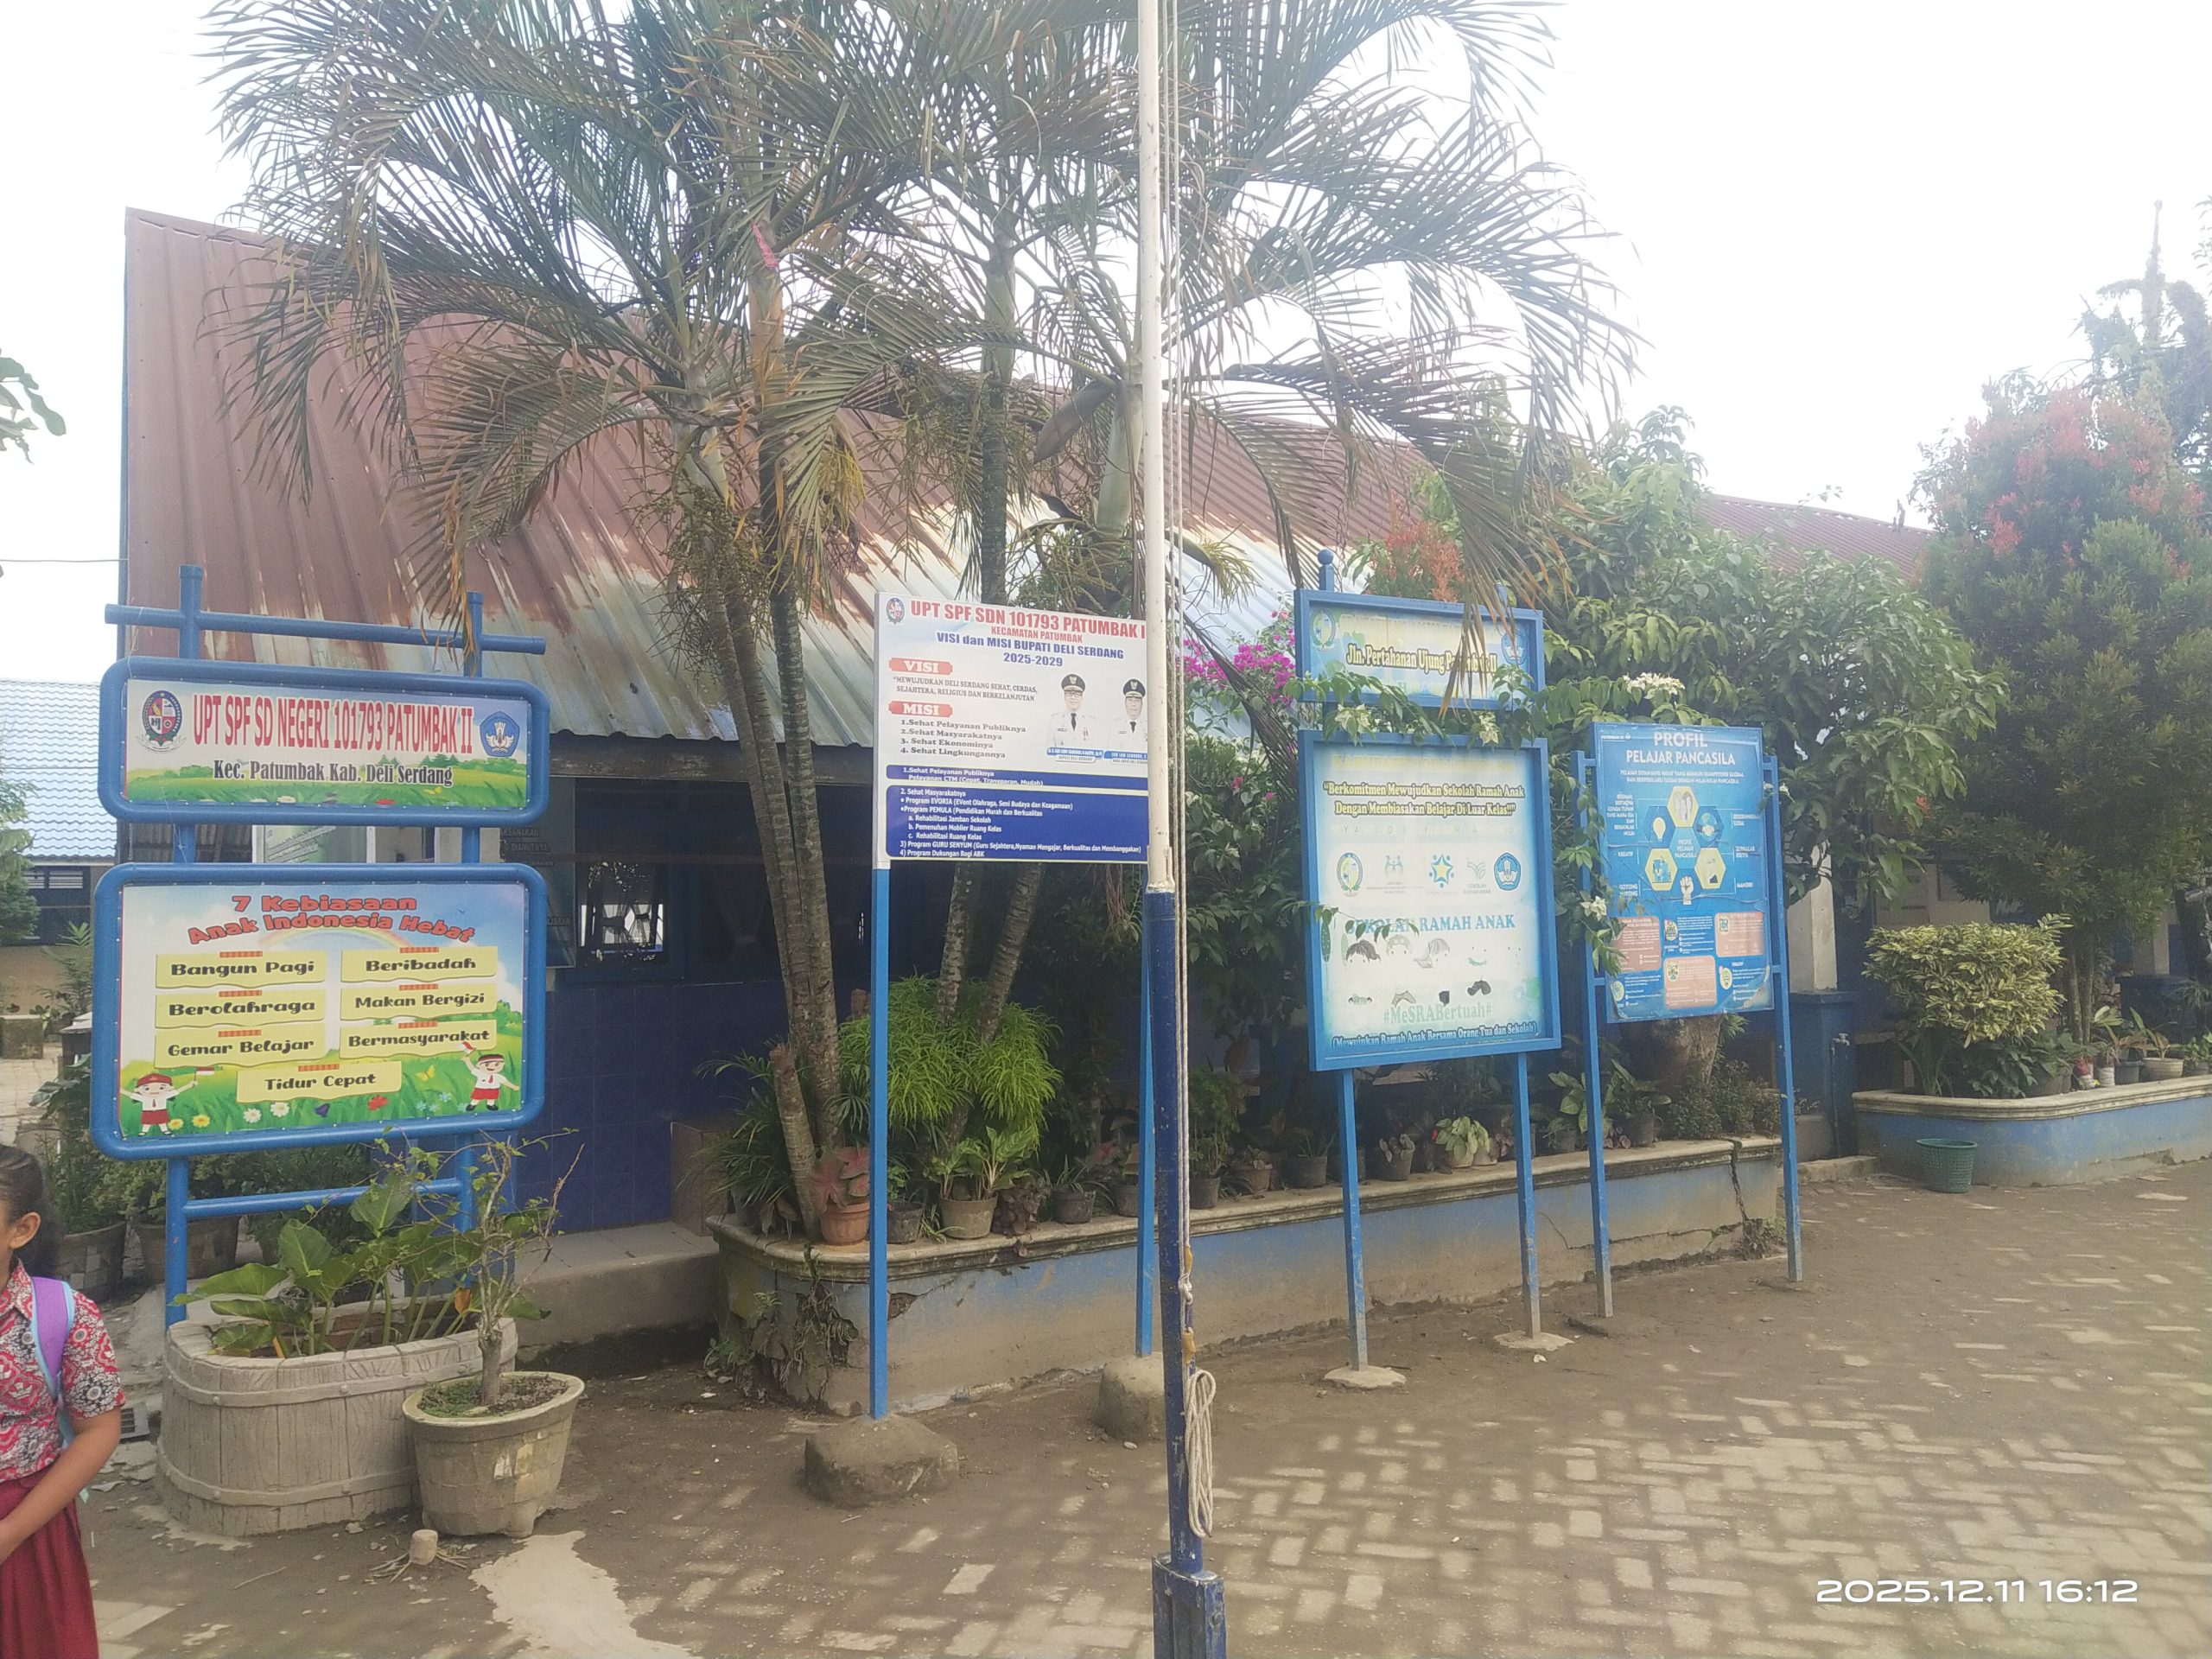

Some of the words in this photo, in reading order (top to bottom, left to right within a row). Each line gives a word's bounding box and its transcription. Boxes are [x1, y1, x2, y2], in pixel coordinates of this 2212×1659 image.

[910, 600, 941, 618] UPT
[944, 604, 971, 620] SPF
[975, 607, 1006, 625] SDN
[1009, 611, 1059, 631] 101793
[1063, 616, 1138, 639] PATUMBAK
[991, 626, 1039, 639] KECAMATAN
[1040, 631, 1084, 644] PATUMBAK
[937, 632, 960, 644] VISI
[963, 635, 984, 646] dan
[987, 637, 1012, 649] MISI
[1014, 639, 1051, 652] BUPATI
[1053, 643, 1075, 655] DELI
[1077, 645, 1124, 659] SERDANG
[904, 660, 939, 673] VISI
[1003, 652, 1064, 667] 2025-2029
[1346, 643, 1364, 665] Jln.
[1365, 645, 1417, 669] Pertahanan
[1418, 649, 1445, 675] Ujung
[896, 685, 937, 696] SEJAHTERA,
[938, 689, 967, 697] RELIGIUS
[982, 692, 1035, 702] BERKELANJUTAN
[960, 681, 990, 690] SERDANG
[1013, 684, 1038, 694] CERDAS,
[902, 702, 939, 715] MISI
[193, 694, 221, 746] UPT
[225, 695, 251, 747] SPF
[254, 697, 273, 747] SD
[277, 698, 330, 750] NEGERI
[334, 701, 383, 751] 101793
[387, 702, 459, 753] PATUMBAK
[460, 706, 474, 754] II
[937, 721, 981, 730] Pelayanan
[982, 723, 1027, 733] Publiknya
[937, 729, 1002, 741] Masyarakatnya
[1653, 732, 1708, 747] PROFIL
[938, 740, 994, 749] Ekonominya
[938, 748, 1006, 759] Lingkungannya
[1626, 749, 1674, 764] PELAJAR
[1675, 751, 1736, 766] PANCASILA
[213, 759, 245, 779] Kec.
[250, 760, 325, 782] Patumbak
[329, 763, 361, 783] Kab.
[365, 764, 394, 784] Deli
[397, 766, 453, 787] Serdang
[929, 767, 963, 776] Pelayanan
[963, 769, 995, 778] Publiknya
[925, 789, 966, 798] Masyarakatnya
[1388, 783, 1442, 799] Mewujudkan
[1443, 784, 1475, 798] Sekolah
[1475, 785, 1503, 798] Ramah
[1503, 785, 1525, 798] Anak
[906, 797, 930, 805] Program
[972, 798, 998, 808] Olahraga,
[1012, 801, 1031, 810] Budaya
[1041, 802, 1073, 810] Keagamaan)
[1334, 800, 1368, 817] Dengan
[1368, 801, 1425, 816] Membiasakan
[1426, 802, 1456, 818] Belajar
[1456, 803, 1466, 816] Di
[1466, 804, 1485, 817] Luar
[231, 895, 251, 913] 7
[261, 894, 417, 913] Kebiasaan
[188, 916, 258, 945] Anak
[263, 912, 393, 931] Indonesia
[397, 914, 476, 944] Hebat
[1420, 916, 1471, 931] RAMAH
[1475, 914, 1516, 930] ANAK
[171, 962, 258, 979] Bangun
[264, 961, 315, 977] Pagi
[365, 957, 477, 972] Beribadah
[168, 999, 316, 1016] Berolahraga
[354, 995, 417, 1009] Makan
[422, 992, 486, 1009] Bergizi
[1382, 1003, 1493, 1026] #MeSRABertuah#
[347, 1029, 490, 1049] Bermasyarakat
[1380, 1032, 1407, 1045] Ramah
[1407, 1030, 1427, 1043] Anak
[1427, 1027, 1458, 1041] Bersama
[1493, 1023, 1506, 1036] dan
[1506, 1021, 1537, 1034] Sekolah)
[167, 1042, 233, 1058] Gemar
[239, 1039, 315, 1055] Belajar
[264, 1077, 318, 1091] Tidur
[322, 1072, 377, 1090] Cepat
